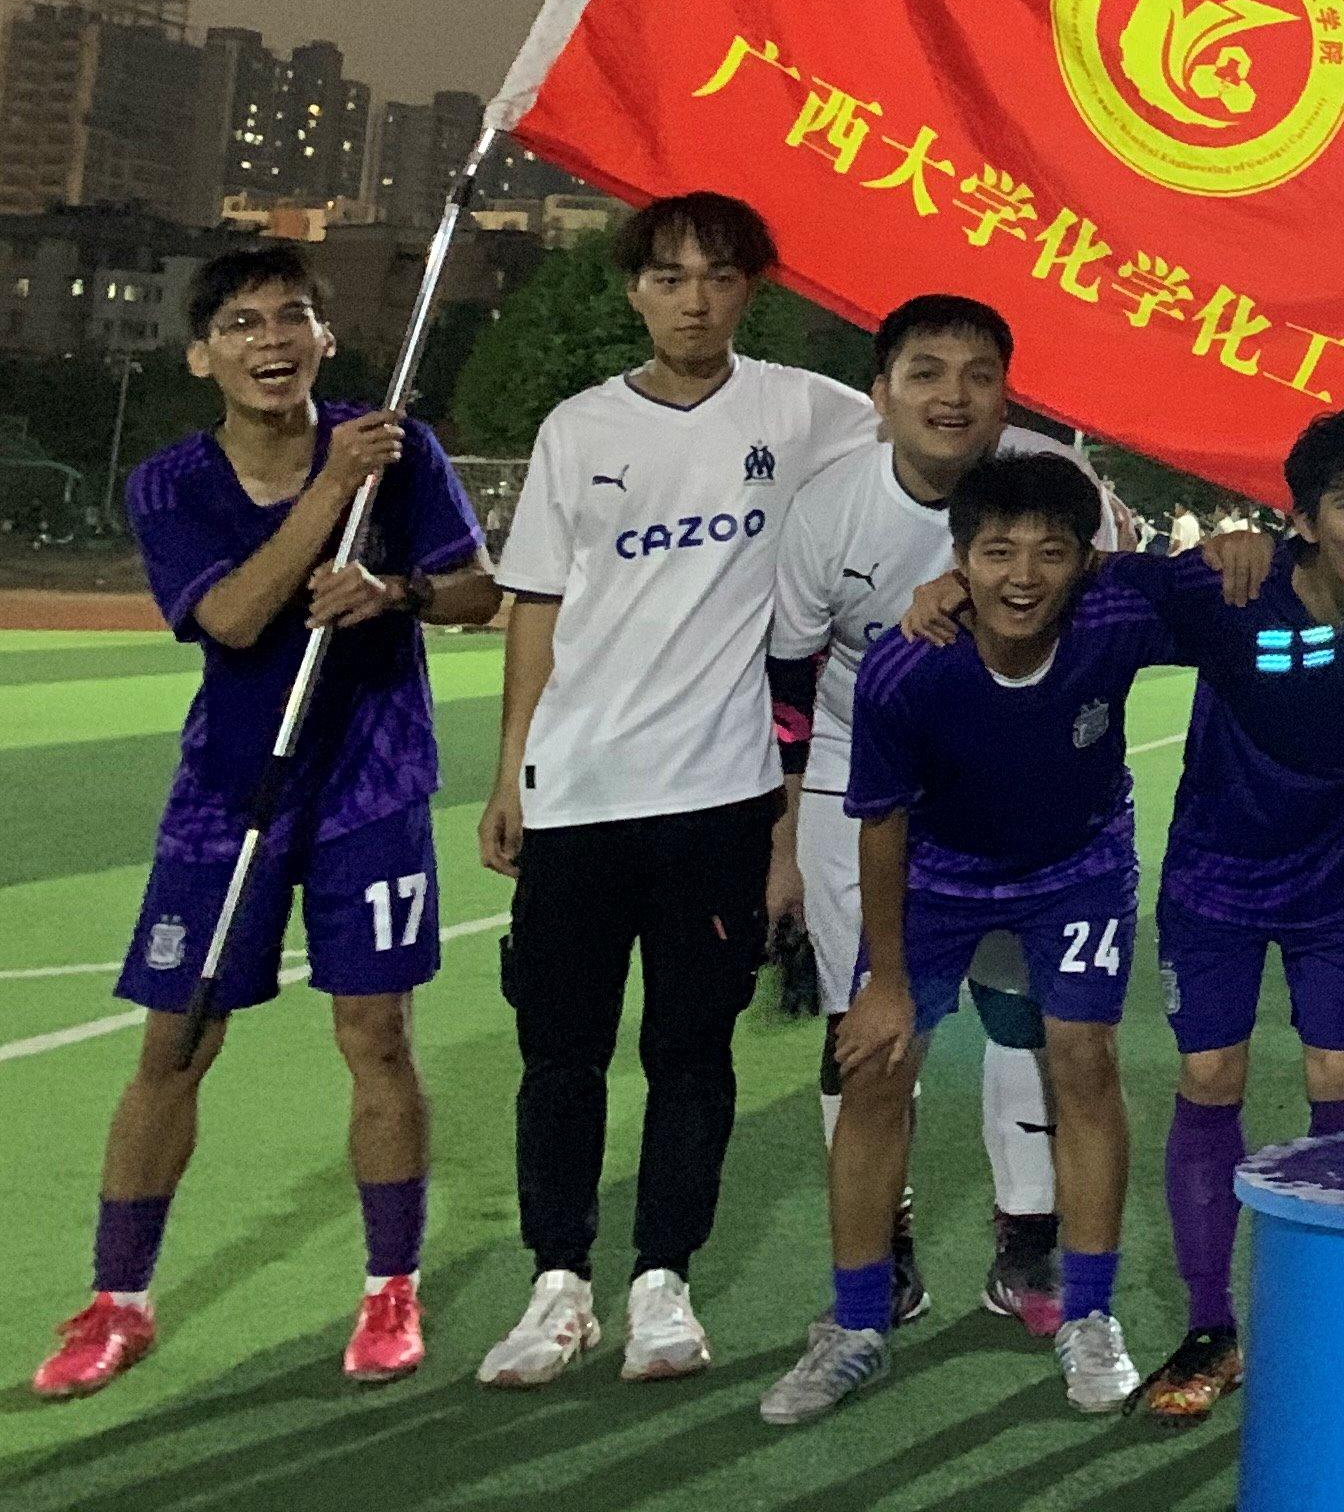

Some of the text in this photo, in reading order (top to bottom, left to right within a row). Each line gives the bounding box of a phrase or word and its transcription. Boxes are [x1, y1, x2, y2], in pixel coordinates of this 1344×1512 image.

[616, 509, 765, 559] CAZOO
[364, 872, 428, 951] 17
[1059, 918, 1120, 976] 24
